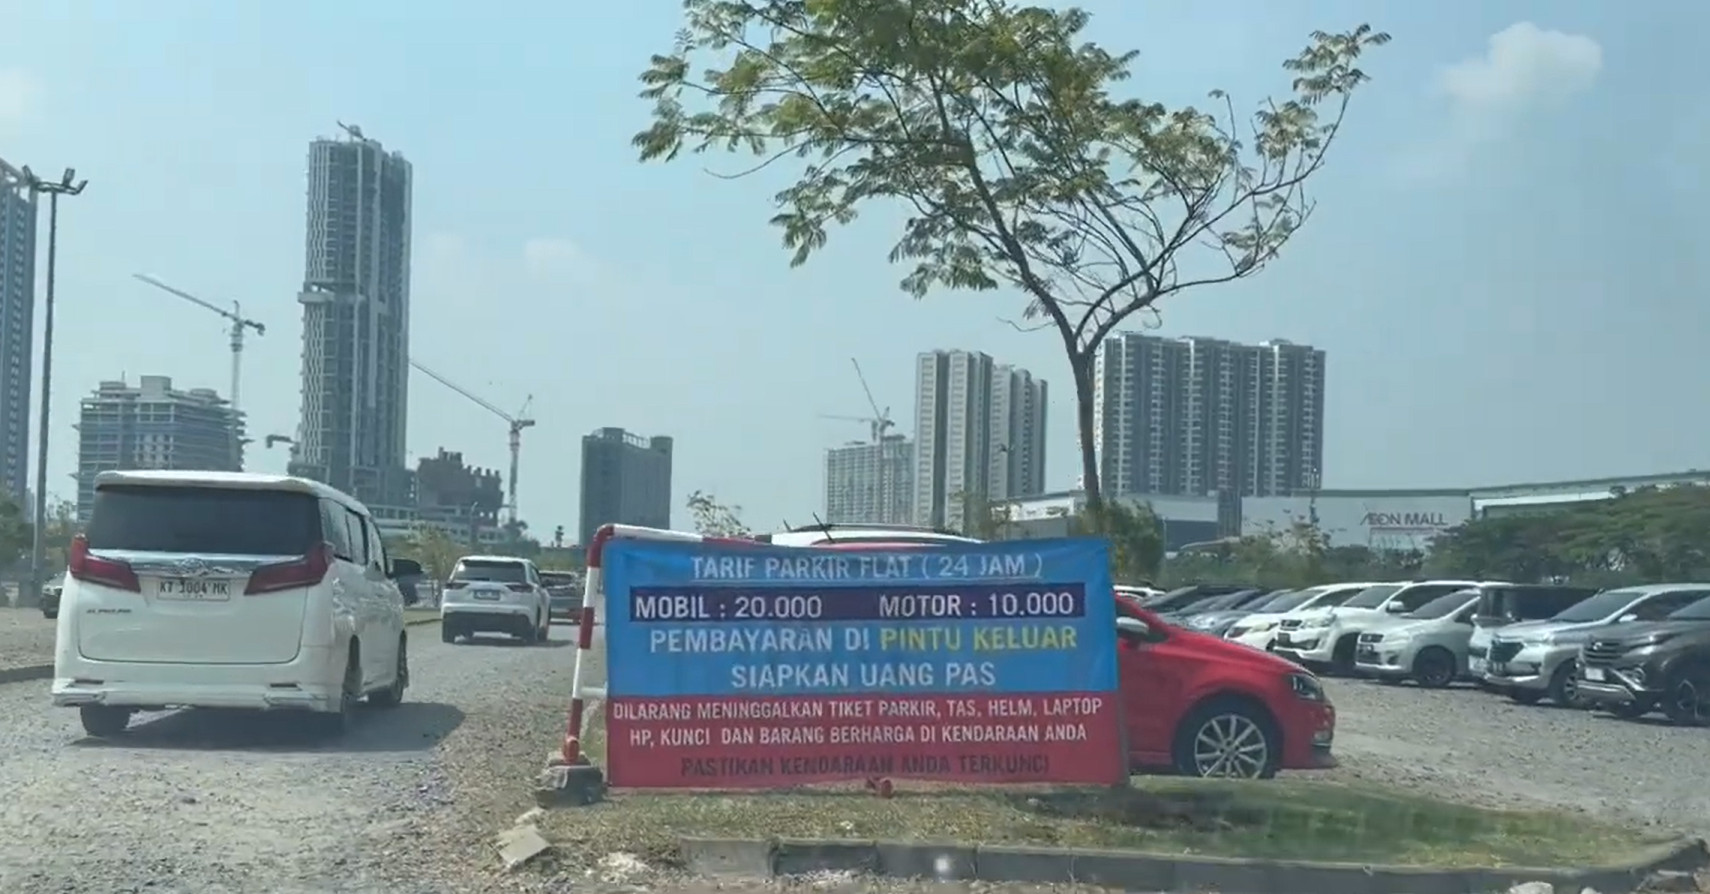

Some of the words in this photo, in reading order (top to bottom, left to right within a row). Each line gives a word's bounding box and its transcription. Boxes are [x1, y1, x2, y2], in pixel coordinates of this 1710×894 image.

[1404, 512, 1448, 526] MALL
[691, 556, 754, 579] TARIF
[765, 556, 850, 580] PARKIR
[860, 555, 912, 578] FLAT
[922, 555, 931, 579] (
[939, 555, 968, 576] 24
[979, 553, 1026, 576] JAM
[1035, 552, 1043, 577] )
[212, 582, 228, 594] MK
[635, 596, 711, 619] MOBIL
[719, 602, 726, 618] :
[734, 595, 823, 618] 20.000
[879, 594, 962, 617] MOTOR
[970, 601, 977, 616] :
[989, 592, 1074, 616] 10.000
[650, 627, 832, 653] PEMBAYARAN
[845, 627, 870, 651] DI
[880, 626, 961, 651] PINTU
[973, 624, 1077, 650] KELUAR
[731, 663, 849, 689] SIAPKAN
[860, 662, 934, 687] UANG
[945, 661, 996, 686] PAS
[613, 702, 691, 720] DILARANG
[697, 701, 823, 719] MENINGGALKAN
[829, 700, 871, 717] TIKET
[879, 700, 941, 719] PARKIR,
[1043, 697, 1103, 715] LAPTOP
[629, 728, 655, 748] HP,
[660, 727, 710, 746] KUNCI
[721, 726, 753, 745] DAN
[759, 725, 825, 745] BARANG
[830, 724, 915, 743] BERHARGA
[920, 724, 936, 742] DI
[942, 723, 1039, 742] KENDARAAN
[1045, 722, 1088, 741] ANDA
[680, 756, 774, 776] PASTIKAN
[780, 754, 894, 776] KENDARAAN
[901, 753, 951, 774] ANDA
[959, 752, 1050, 774] TERKUNCI
